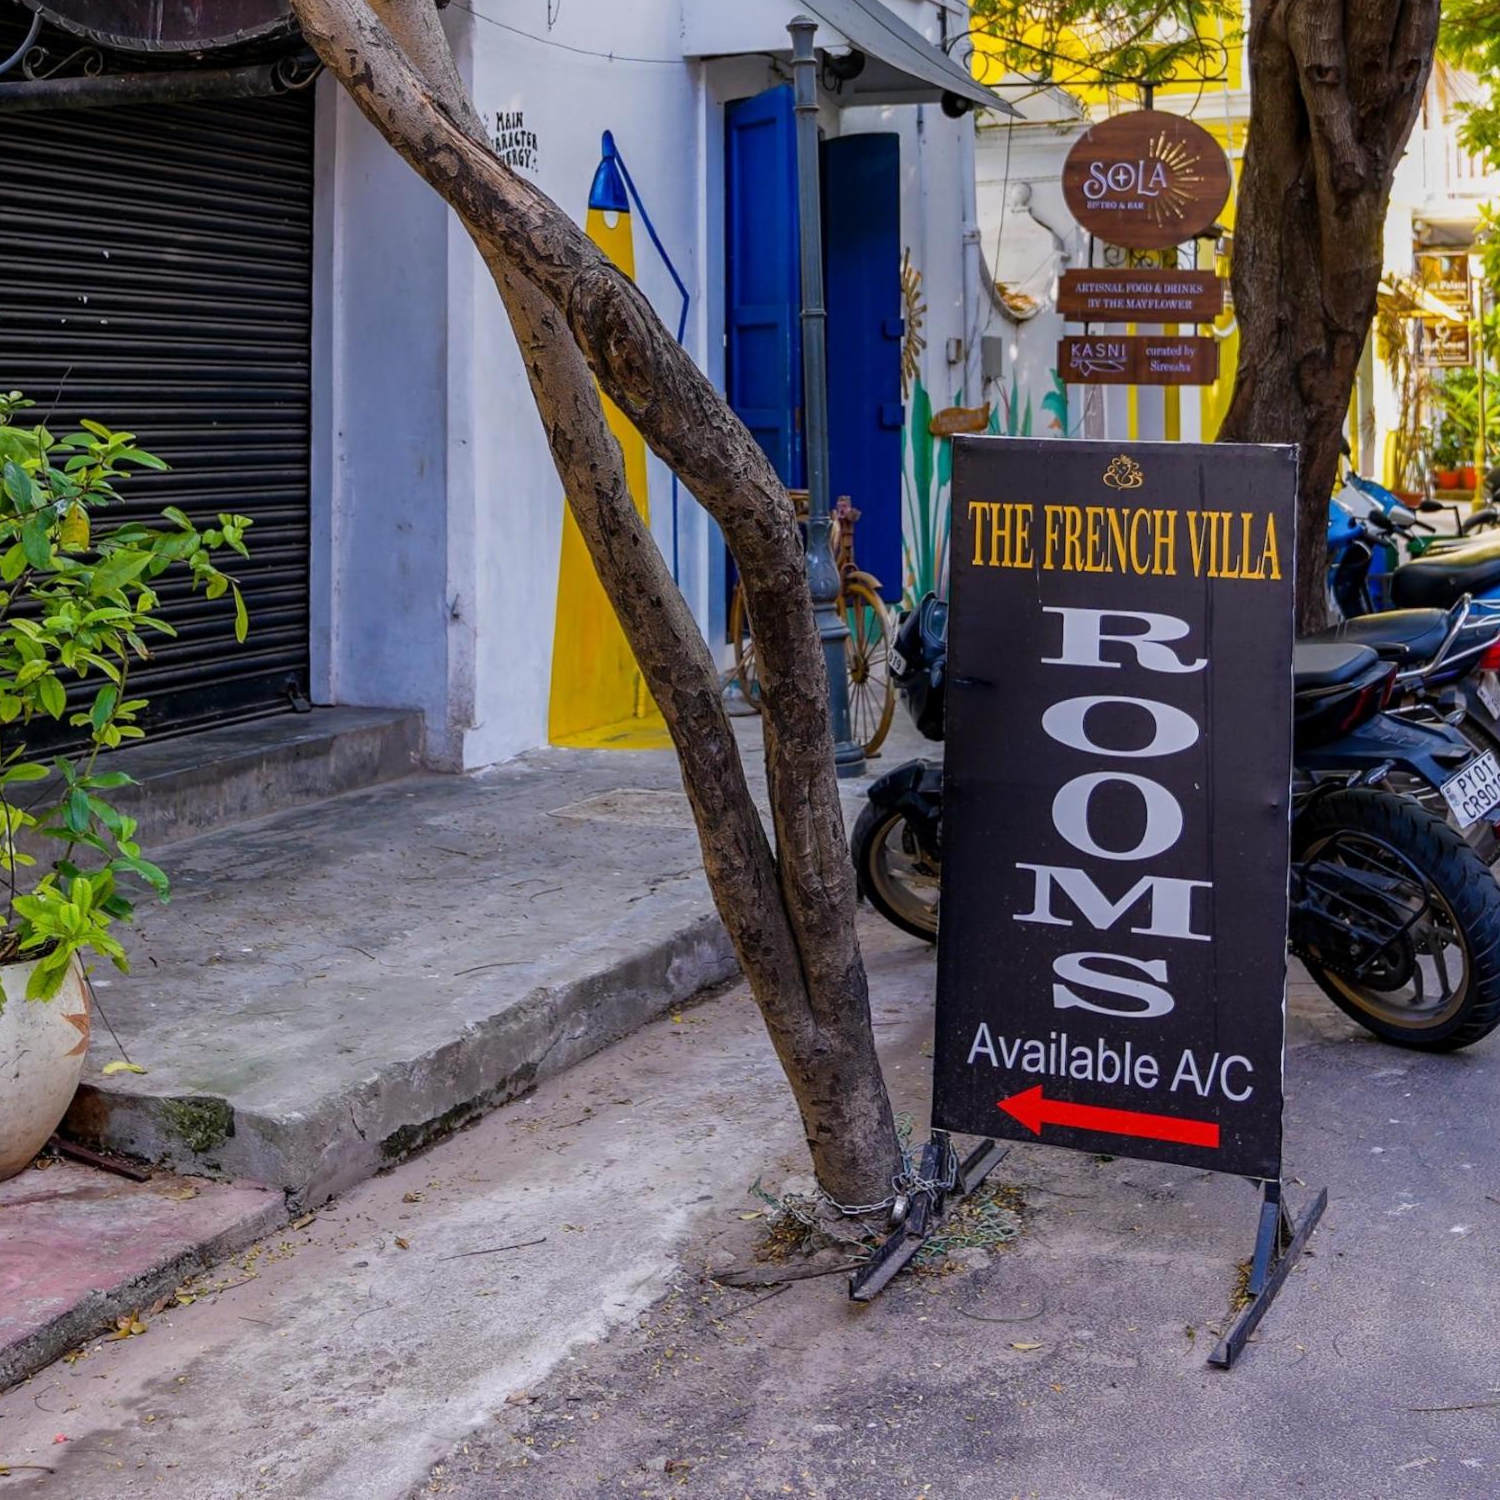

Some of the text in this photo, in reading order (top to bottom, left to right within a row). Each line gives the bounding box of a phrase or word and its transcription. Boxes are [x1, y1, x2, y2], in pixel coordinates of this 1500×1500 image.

[495, 111, 524, 132] MAIN
[491, 130, 538, 152] ARACTER
[499, 148, 532, 169] ERGY
[1083, 160, 1168, 199] SOLA
[1127, 201, 1144, 210] BAR
[1075, 283, 1203, 294] ARTISNAL FOOD & DRINKS
[1088, 299, 1193, 310] BY THE MAYFLOWER
[1071, 343, 1127, 358] KASNI
[1146, 345, 1196, 358] curated by
[968, 501, 1282, 581] THE FRENCH VILLA
[1457, 758, 1494, 798] PY01
[1012, 605, 1214, 1019] ROOMS
[967, 1022, 1253, 1102] Available A/C
